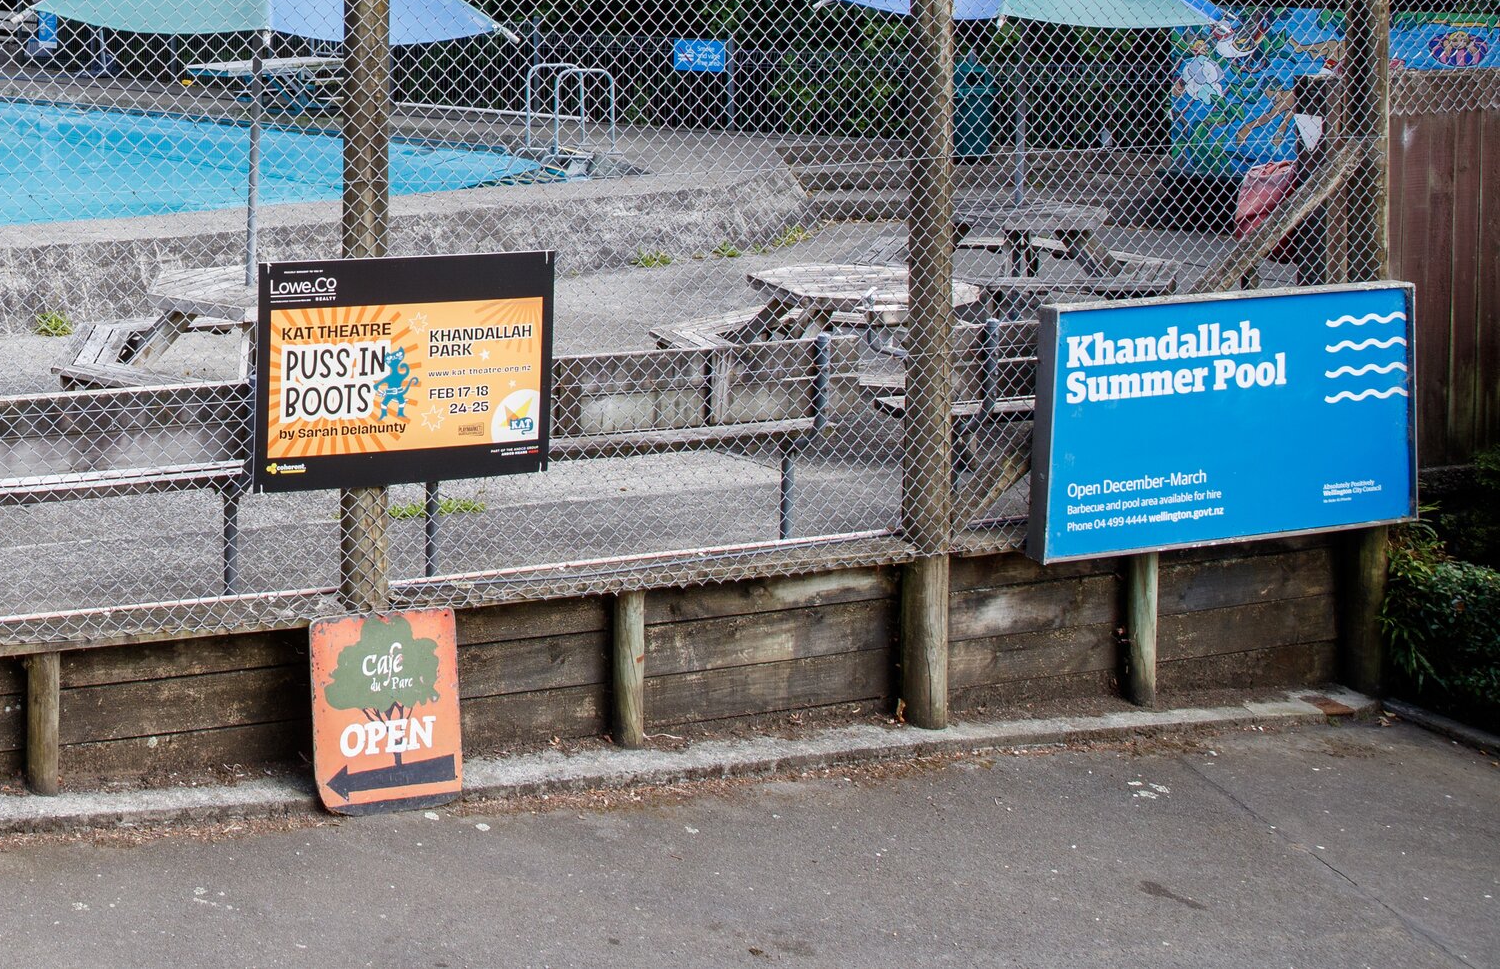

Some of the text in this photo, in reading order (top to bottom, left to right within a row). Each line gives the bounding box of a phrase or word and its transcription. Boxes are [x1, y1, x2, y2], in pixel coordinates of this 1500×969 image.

[282, 322, 392, 340] KAT THEATRE
[429, 325, 532, 343] KHANDALLAH
[429, 343, 472, 357] PARK
[1066, 320, 1262, 368] Khandallah
[286, 346, 386, 381] PUSS IN
[1066, 352, 1287, 404] Summer Pool
[285, 383, 371, 418] BOOTS
[429, 385, 489, 399] FEB 17-18
[449, 401, 489, 414] 24-25
[279, 422, 406, 440] by Sarah Delahunty
[511, 418, 532, 429] KAT
[1067, 482, 1101, 499] Open
[1067, 489, 1222, 515] Barbecue and pool area available for hire
[1067, 506, 1224, 532] Phone 04 499 4444 wellington.govt.nz
[370, 676, 413, 692] du Parc
[339, 715, 437, 758] OPEN
